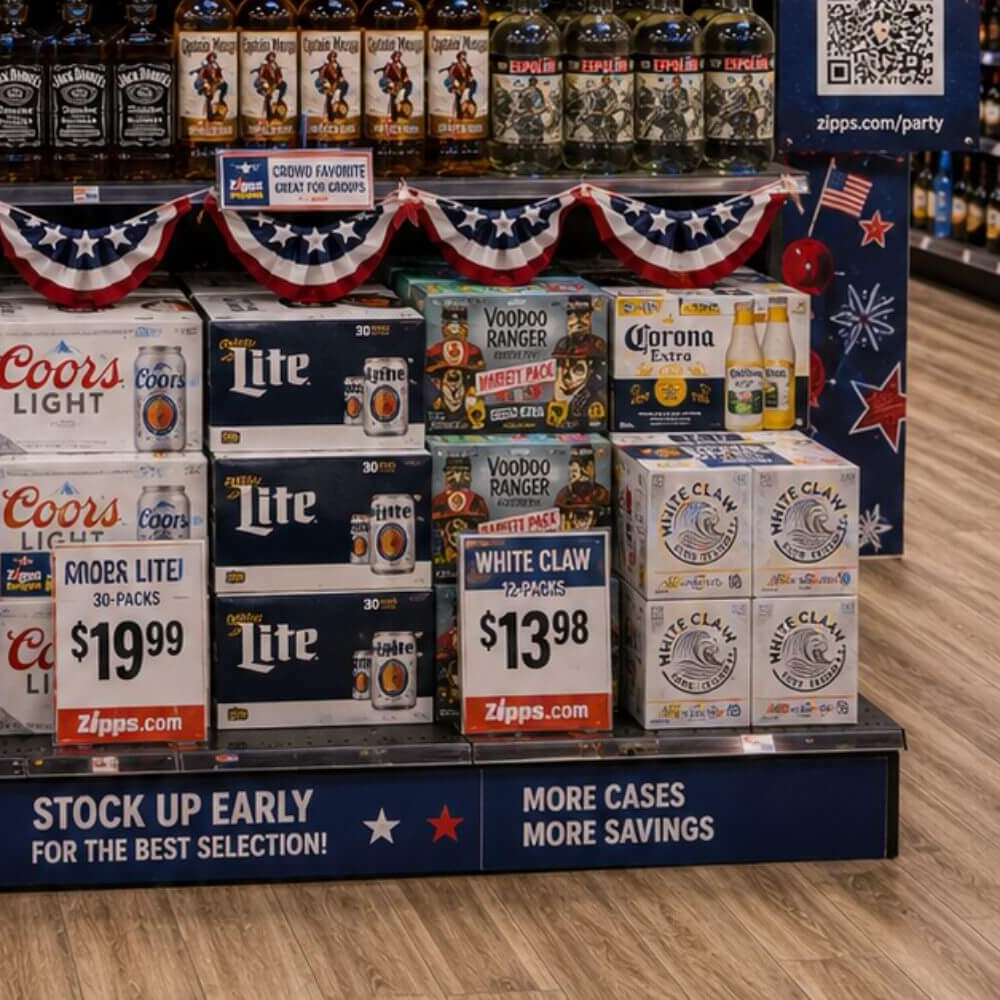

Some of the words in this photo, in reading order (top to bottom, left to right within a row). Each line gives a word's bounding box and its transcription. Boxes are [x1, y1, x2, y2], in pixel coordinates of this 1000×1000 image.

[816, 114, 944, 135] zipps.com/party
[484, 307, 548, 327] VOODOO
[356, 325, 371, 337] 30
[487, 330, 547, 348] RANGER
[625, 324, 715, 355] Corona
[136, 368, 185, 389] Coors
[229, 346, 312, 397] Lite
[14, 393, 104, 414] LIGHT
[363, 461, 378, 473] 30
[487, 457, 550, 477] VOODOO
[490, 478, 550, 497] RANGER
[3, 486, 121, 530] Coors
[138, 508, 189, 529] Coors
[235, 485, 318, 536] Lite
[475, 550, 534, 573] WHITE
[539, 548, 591, 571] CLAW
[93, 591, 161, 608] 30-PACKS
[363, 598, 380, 611] 30
[236, 622, 319, 674] Lite
[485, 698, 589, 725] Zipps.com
[77, 711, 182, 738] Zipps.com
[523, 785, 597, 812] MORE
[604, 782, 685, 809] CASES
[32, 795, 145, 831] STOCK
[155, 793, 202, 827] UP
[211, 789, 315, 826] EARLY
[523, 820, 597, 847] MORE
[604, 816, 715, 845] SAVINGS
[31, 840, 77, 865] FOR
[85, 838, 128, 862] THE
[135, 836, 190, 861] BEST
[197, 832, 327, 859] SELECTION!
